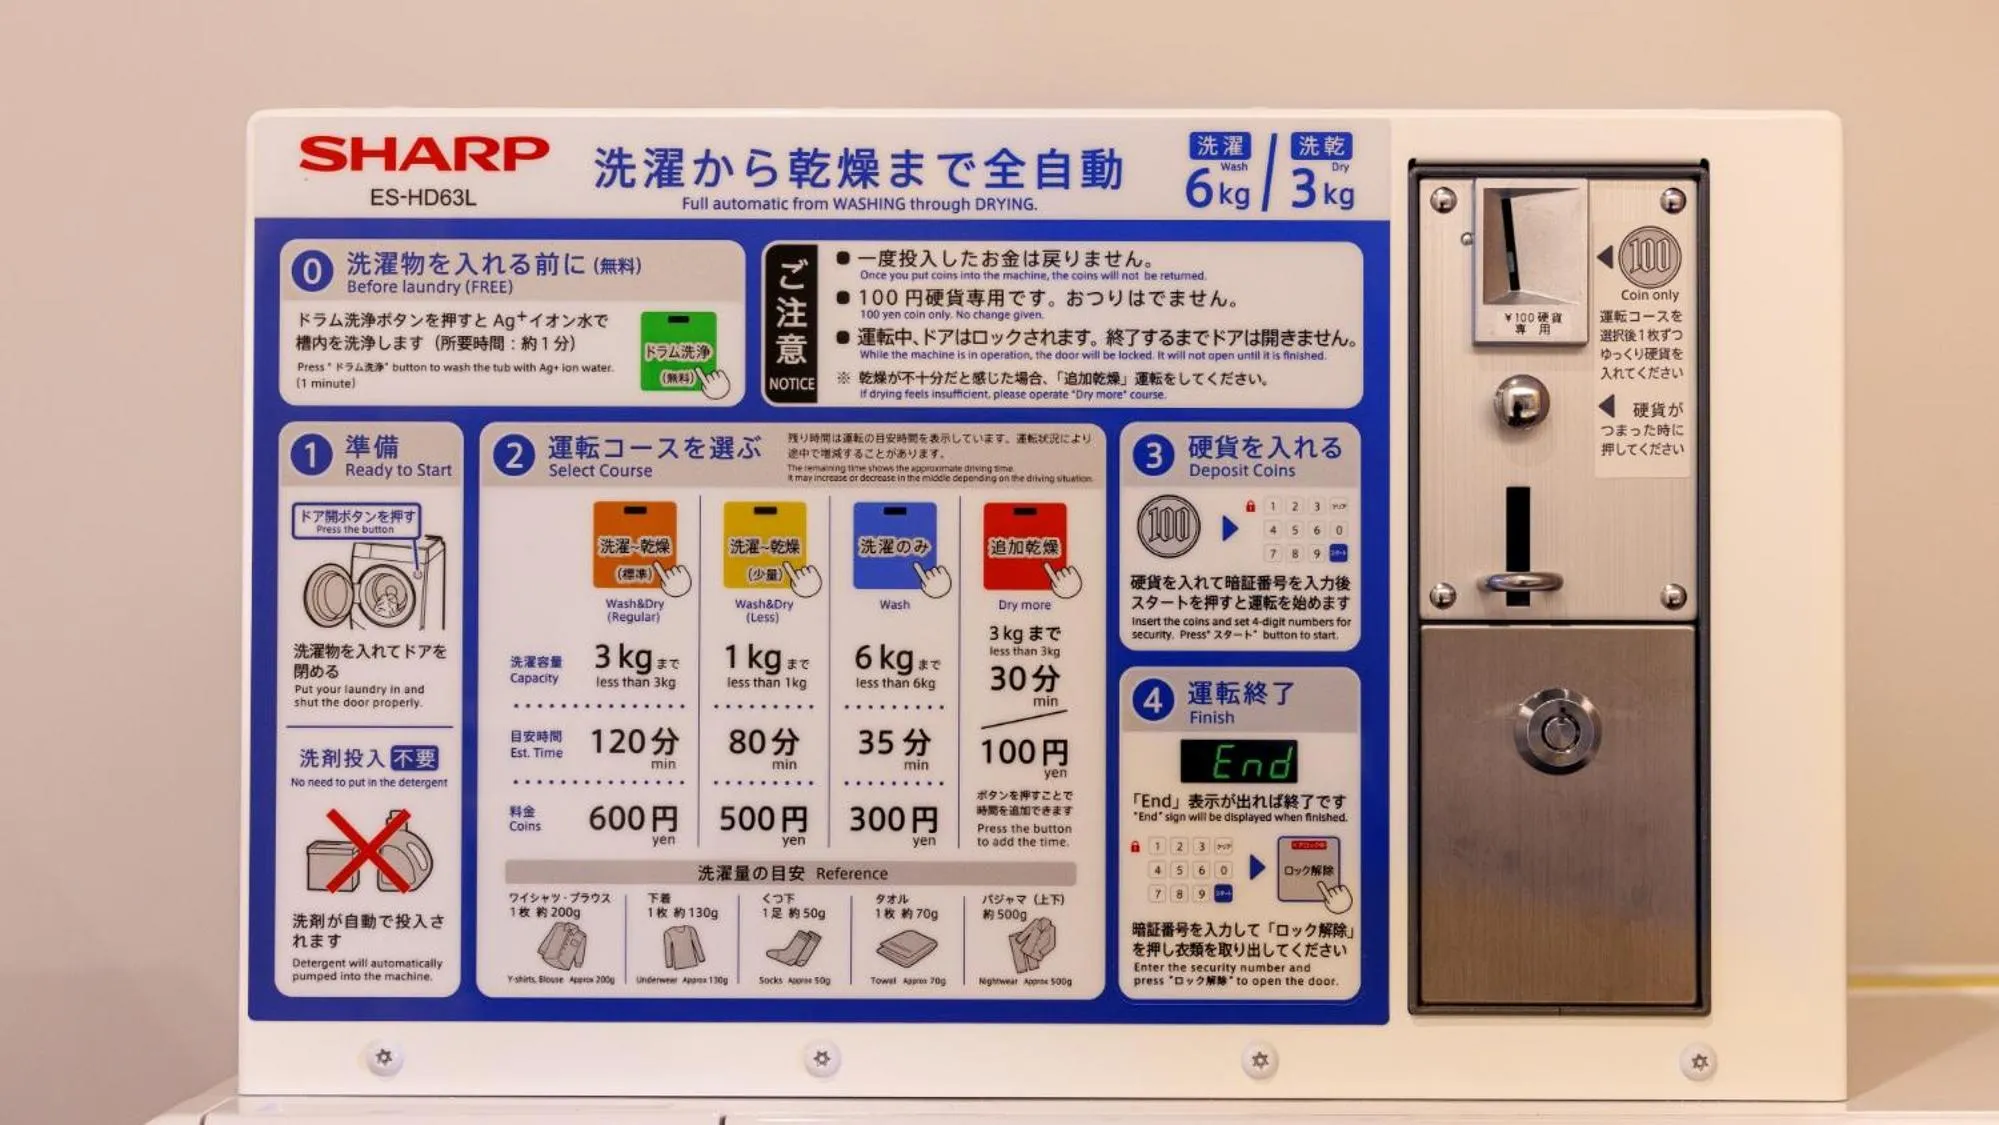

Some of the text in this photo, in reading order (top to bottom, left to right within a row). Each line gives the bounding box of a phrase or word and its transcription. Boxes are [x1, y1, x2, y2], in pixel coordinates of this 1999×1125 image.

[1197, 135, 1244, 155] 洗濯
[1299, 136, 1345, 156] 洗乾
[299, 136, 551, 172] SHARP
[594, 147, 1123, 190] 洗濯から乾燥まで全自動
[1220, 161, 1249, 172] Wash
[1331, 161, 1351, 173] Dry
[370, 188, 478, 206] ES-HD63L
[682, 197, 1038, 214] Full automatic from WASHING through DRYING.
[857, 249, 1151, 268] 一度投入したお金は戻りません。
[1628, 237, 1672, 274] 100
[346, 251, 642, 276] 洗濯物を入れる前に (無料)
[303, 258, 322, 284] 0
[347, 280, 514, 296] Before laundry (FREE)
[1620, 289, 1681, 303] Coin only
[775, 259, 809, 364] ご注意
[860, 309, 1044, 322] 100 yen coin only. No change given.
[1599, 310, 1683, 323] 運転コースを
[1599, 328, 1684, 342] 選択後1枚ずつ
[645, 343, 711, 361] ドラム洗浄
[1600, 347, 1684, 360] ゆっくり硬貨を
[1600, 366, 1684, 380] 入れてください
[296, 377, 356, 389] (1 minute)
[769, 378, 816, 390] NOTICE
[1632, 402, 1684, 418] 硬貨が
[1600, 424, 1685, 436] つまった時に
[344, 434, 399, 459] 準備
[547, 435, 762, 460] 運転コースを選ぶ
[1187, 435, 1342, 459] 硬貨を入れる
[1600, 443, 1685, 456] 押してください
[304, 442, 316, 468] 1
[505, 442, 524, 468] 2
[1146, 442, 1163, 468] 3
[345, 463, 453, 480] Ready to Start
[548, 464, 653, 477] Select Course
[1189, 464, 1297, 479] Deposit Coins
[301, 509, 417, 524] ドア開ボタンを押す
[316, 524, 395, 534] Press the button
[1148, 505, 1190, 543] 100
[860, 538, 930, 555] 洗濯のみ
[990, 538, 1060, 556] 追加乾燥
[1129, 574, 1351, 591] 硬貨を入れて暗証番号を入力後
[605, 599, 665, 611] Wash&Dry
[734, 599, 794, 611] Wash&Dry
[879, 600, 911, 610] Wash
[998, 600, 1052, 612] Dry more
[1131, 595, 1351, 611] スタートを押すと運転を始めます
[607, 612, 661, 624] (Regular)
[745, 612, 780, 624] (Less)
[293, 643, 447, 659] 洗濯物を入れてドアを
[989, 646, 1061, 659] less than 3kg
[510, 656, 563, 668] 洗濯容量
[293, 664, 340, 679] 閉める
[509, 673, 560, 685] Capacity
[596, 675, 677, 690] less than 3kg
[727, 676, 808, 690] less than 1kg
[855, 677, 937, 691] less than 6kg
[1142, 687, 1163, 713] 4
[1187, 681, 1295, 705] 運転終了
[1033, 696, 1059, 707] min
[1189, 711, 1235, 724] Finish
[510, 730, 563, 743] 目安時間
[299, 748, 386, 768] 洗剤投入
[393, 749, 436, 768] 不要
[510, 747, 564, 758] Est. Time
[650, 758, 677, 769] min
[771, 759, 798, 770] min
[903, 759, 930, 770] min
[1212, 745, 1294, 779] End
[1043, 766, 1068, 780] yen
[290, 778, 449, 789] No need to put in the detergent
[976, 790, 1074, 801] ボタンを押すことで
[509, 805, 536, 818] 料金
[976, 805, 1074, 816] 時間を追加できます
[508, 821, 542, 831] Coins
[651, 835, 676, 847] yen
[781, 836, 806, 848] yen
[912, 837, 937, 848] yen
[697, 865, 889, 881] 洗濯量の目安 Reference
[1284, 865, 1335, 876] ロック解除
[647, 893, 672, 904] 下着
[762, 893, 795, 904] くつ下
[875, 894, 910, 904] タオル
[292, 913, 445, 929] 洗剤が自動で投入さ
[292, 933, 342, 948] れます
[1132, 942, 1347, 958] を押し衣類を取り出してください
